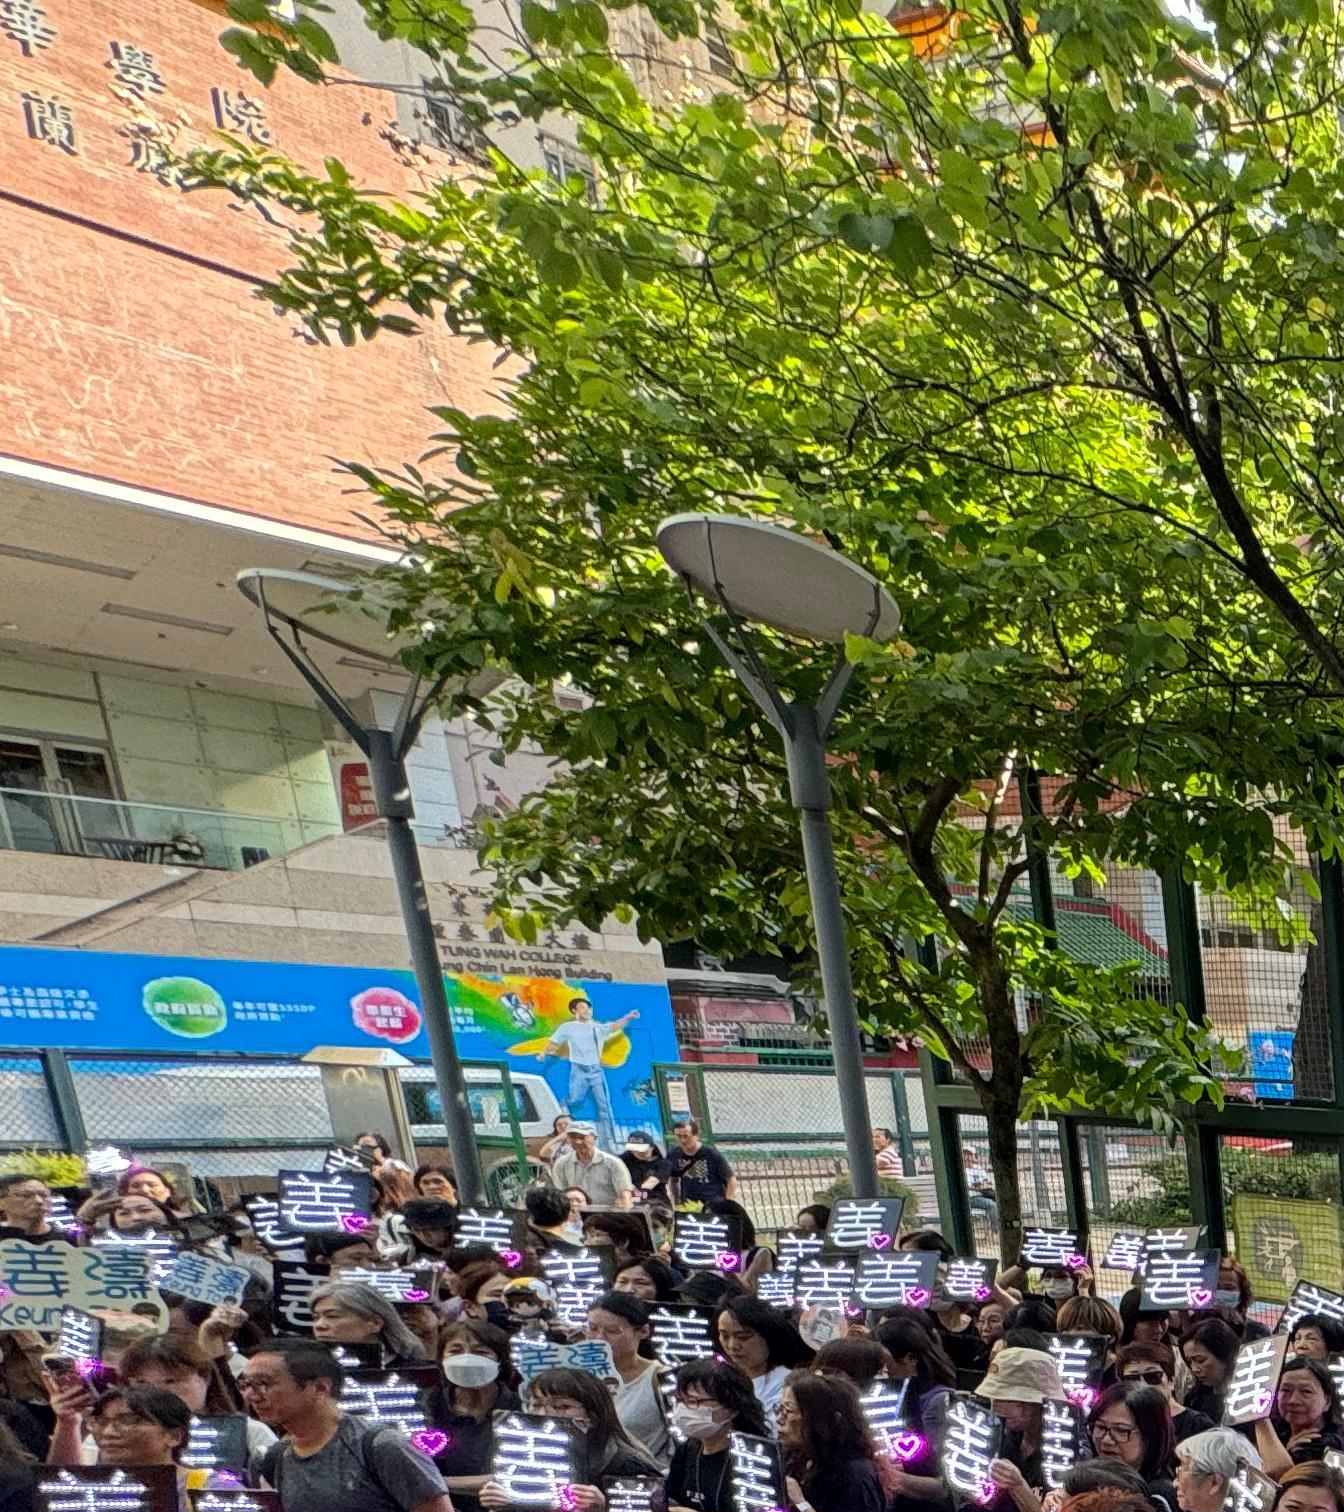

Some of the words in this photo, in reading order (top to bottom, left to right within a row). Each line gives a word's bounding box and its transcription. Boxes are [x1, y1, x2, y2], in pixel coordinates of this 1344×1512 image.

[441, 945, 480, 959] TUNG
[483, 947, 516, 961] WAH
[520, 950, 582, 966] COLLEGE
[467, 962, 498, 974] Chin
[501, 963, 525, 975] Lan
[565, 968, 613, 982] Building
[280, 1174, 355, 1230] 姜
[831, 1202, 886, 1248] 姜
[674, 1214, 729, 1266] 姜
[1022, 1228, 1078, 1265] 姜
[857, 1255, 922, 1304] 姜
[1147, 1252, 1205, 1305] 姜
[0, 1302, 64, 1326] Keun
[1227, 1342, 1277, 1417] 姜
[494, 1417, 570, 1504] 姜
[944, 1401, 992, 1492] 姜
